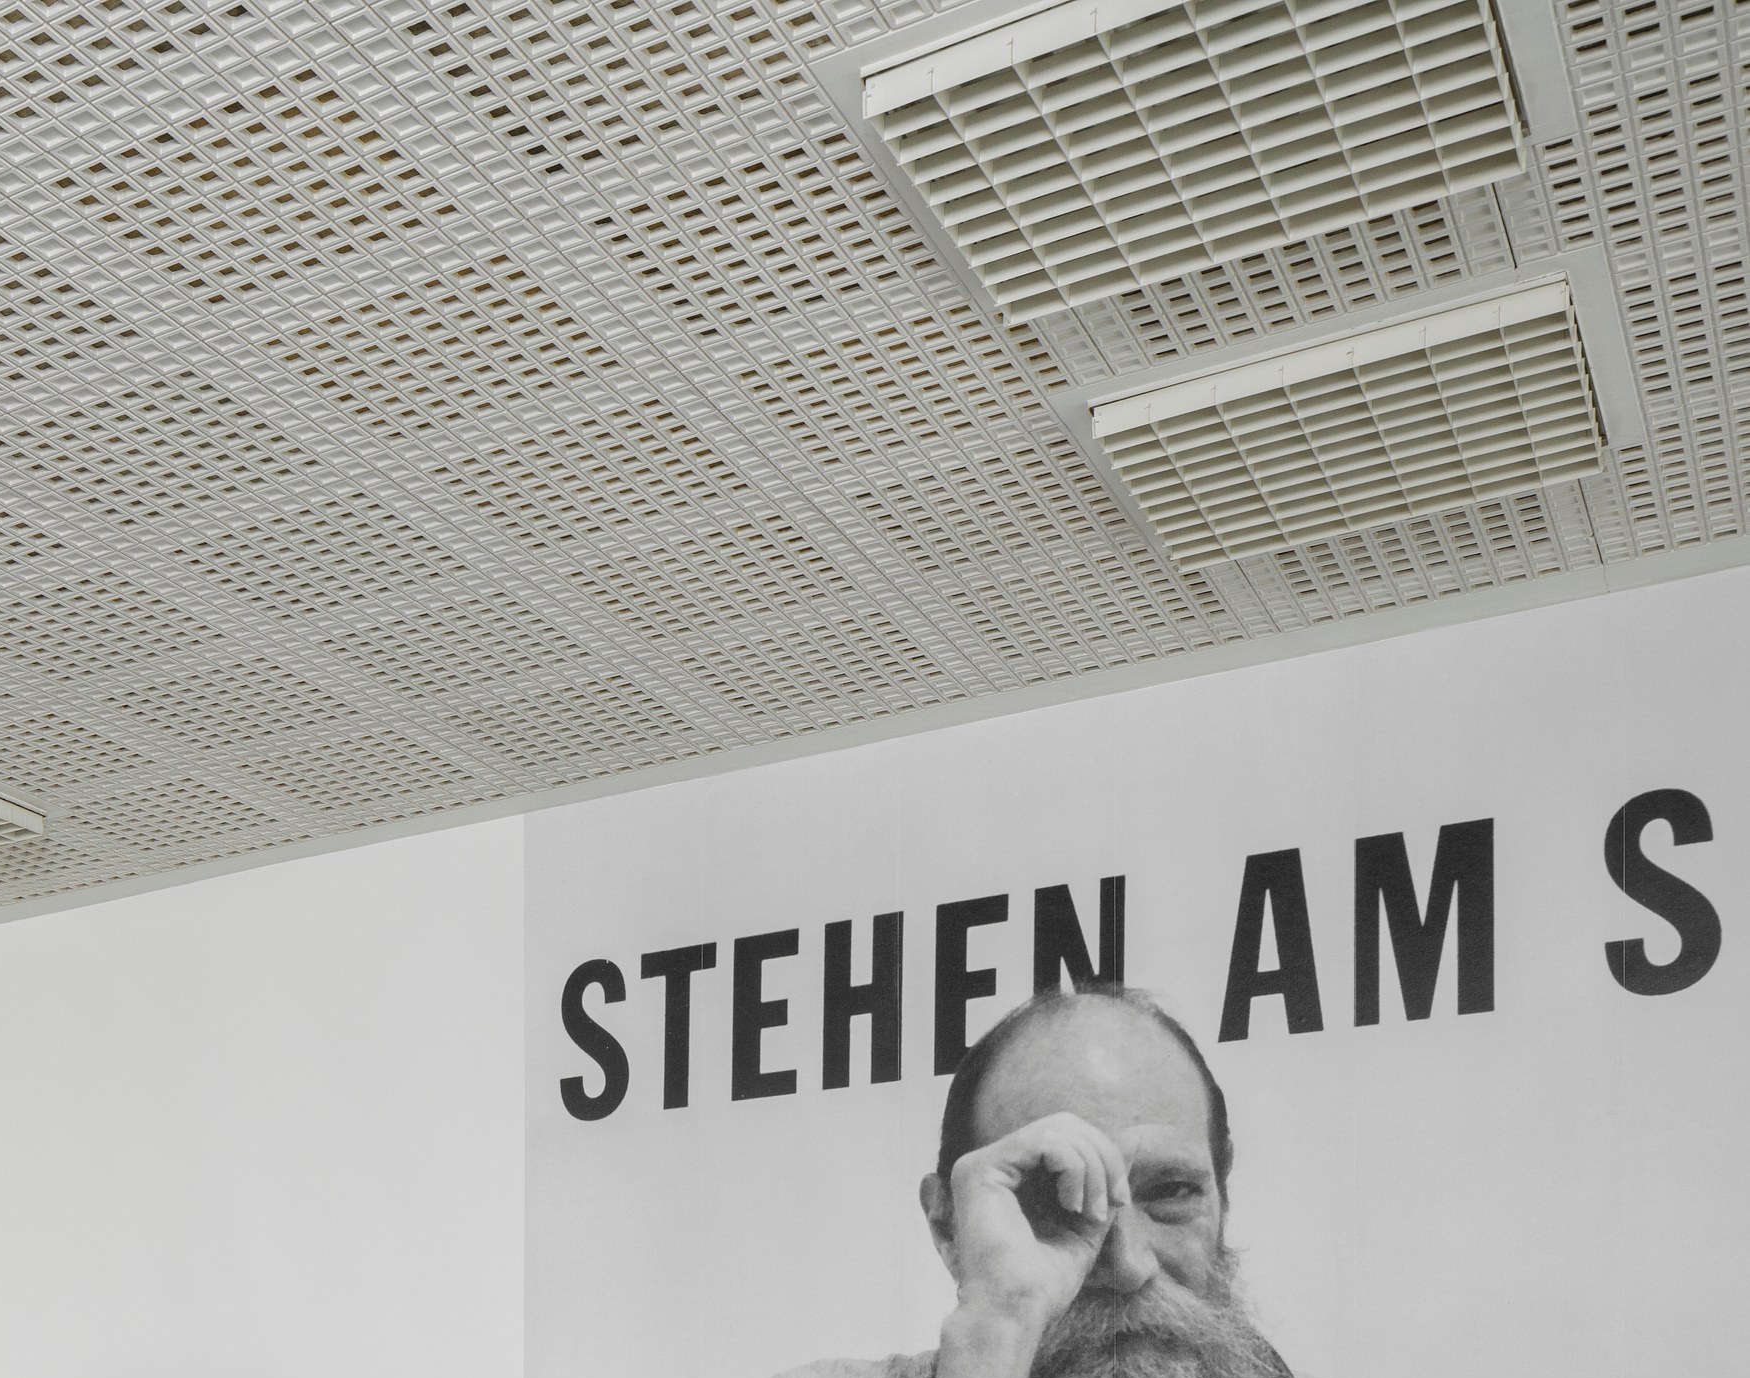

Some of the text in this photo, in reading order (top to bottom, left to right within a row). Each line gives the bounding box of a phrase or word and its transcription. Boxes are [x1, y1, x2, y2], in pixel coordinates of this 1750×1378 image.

[559, 788, 1722, 1122] STEHEN AM S
